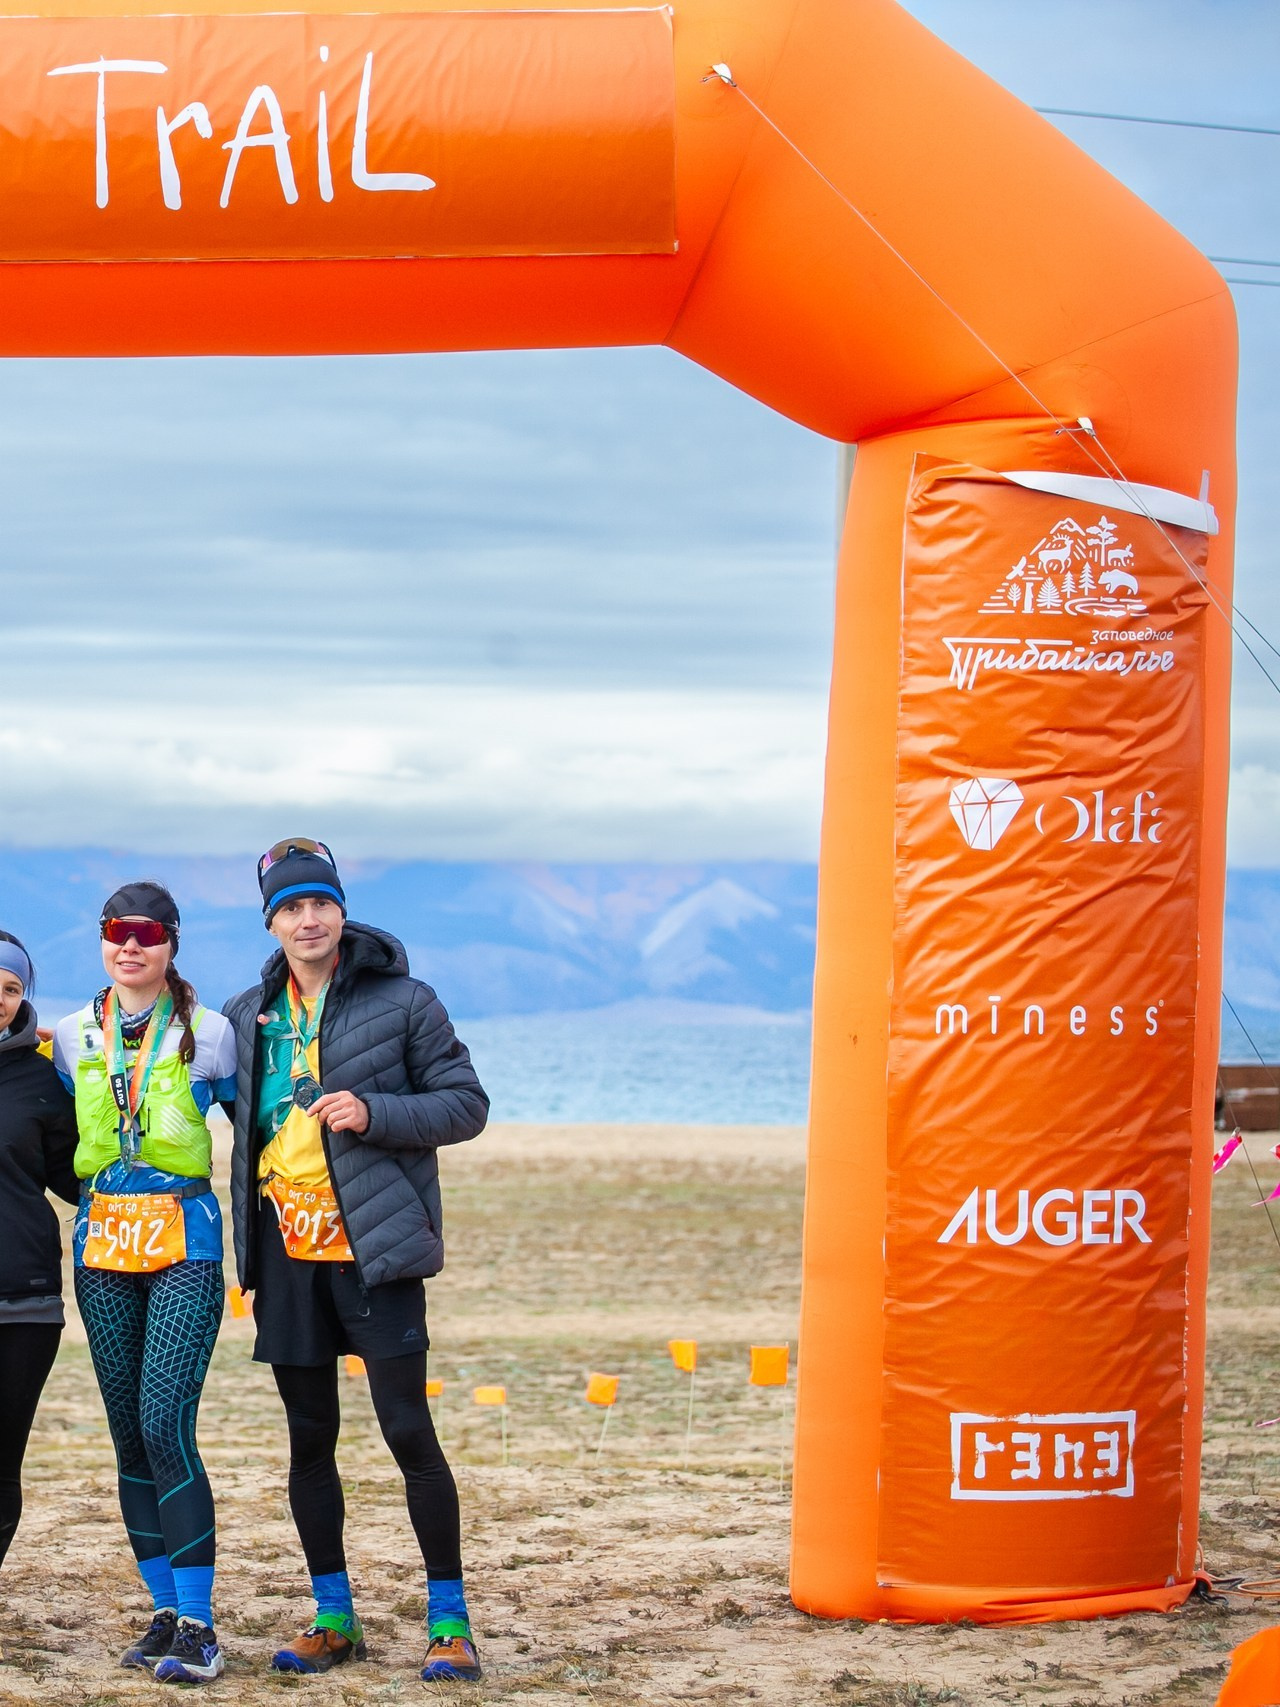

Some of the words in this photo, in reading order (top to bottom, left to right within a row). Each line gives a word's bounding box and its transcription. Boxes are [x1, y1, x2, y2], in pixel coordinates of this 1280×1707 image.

[1090, 627, 1174, 644] заповедное
[115, 1077, 122, 1088] 50
[116, 1089, 125, 1106] OUT
[288, 1189, 303, 1204] OUT
[108, 1203, 124, 1216] OUT
[125, 1203, 137, 1216] 50
[936, 1186, 1153, 1246] AUGER
[282, 1202, 340, 1245] 5013
[104, 1216, 165, 1258] 5012
